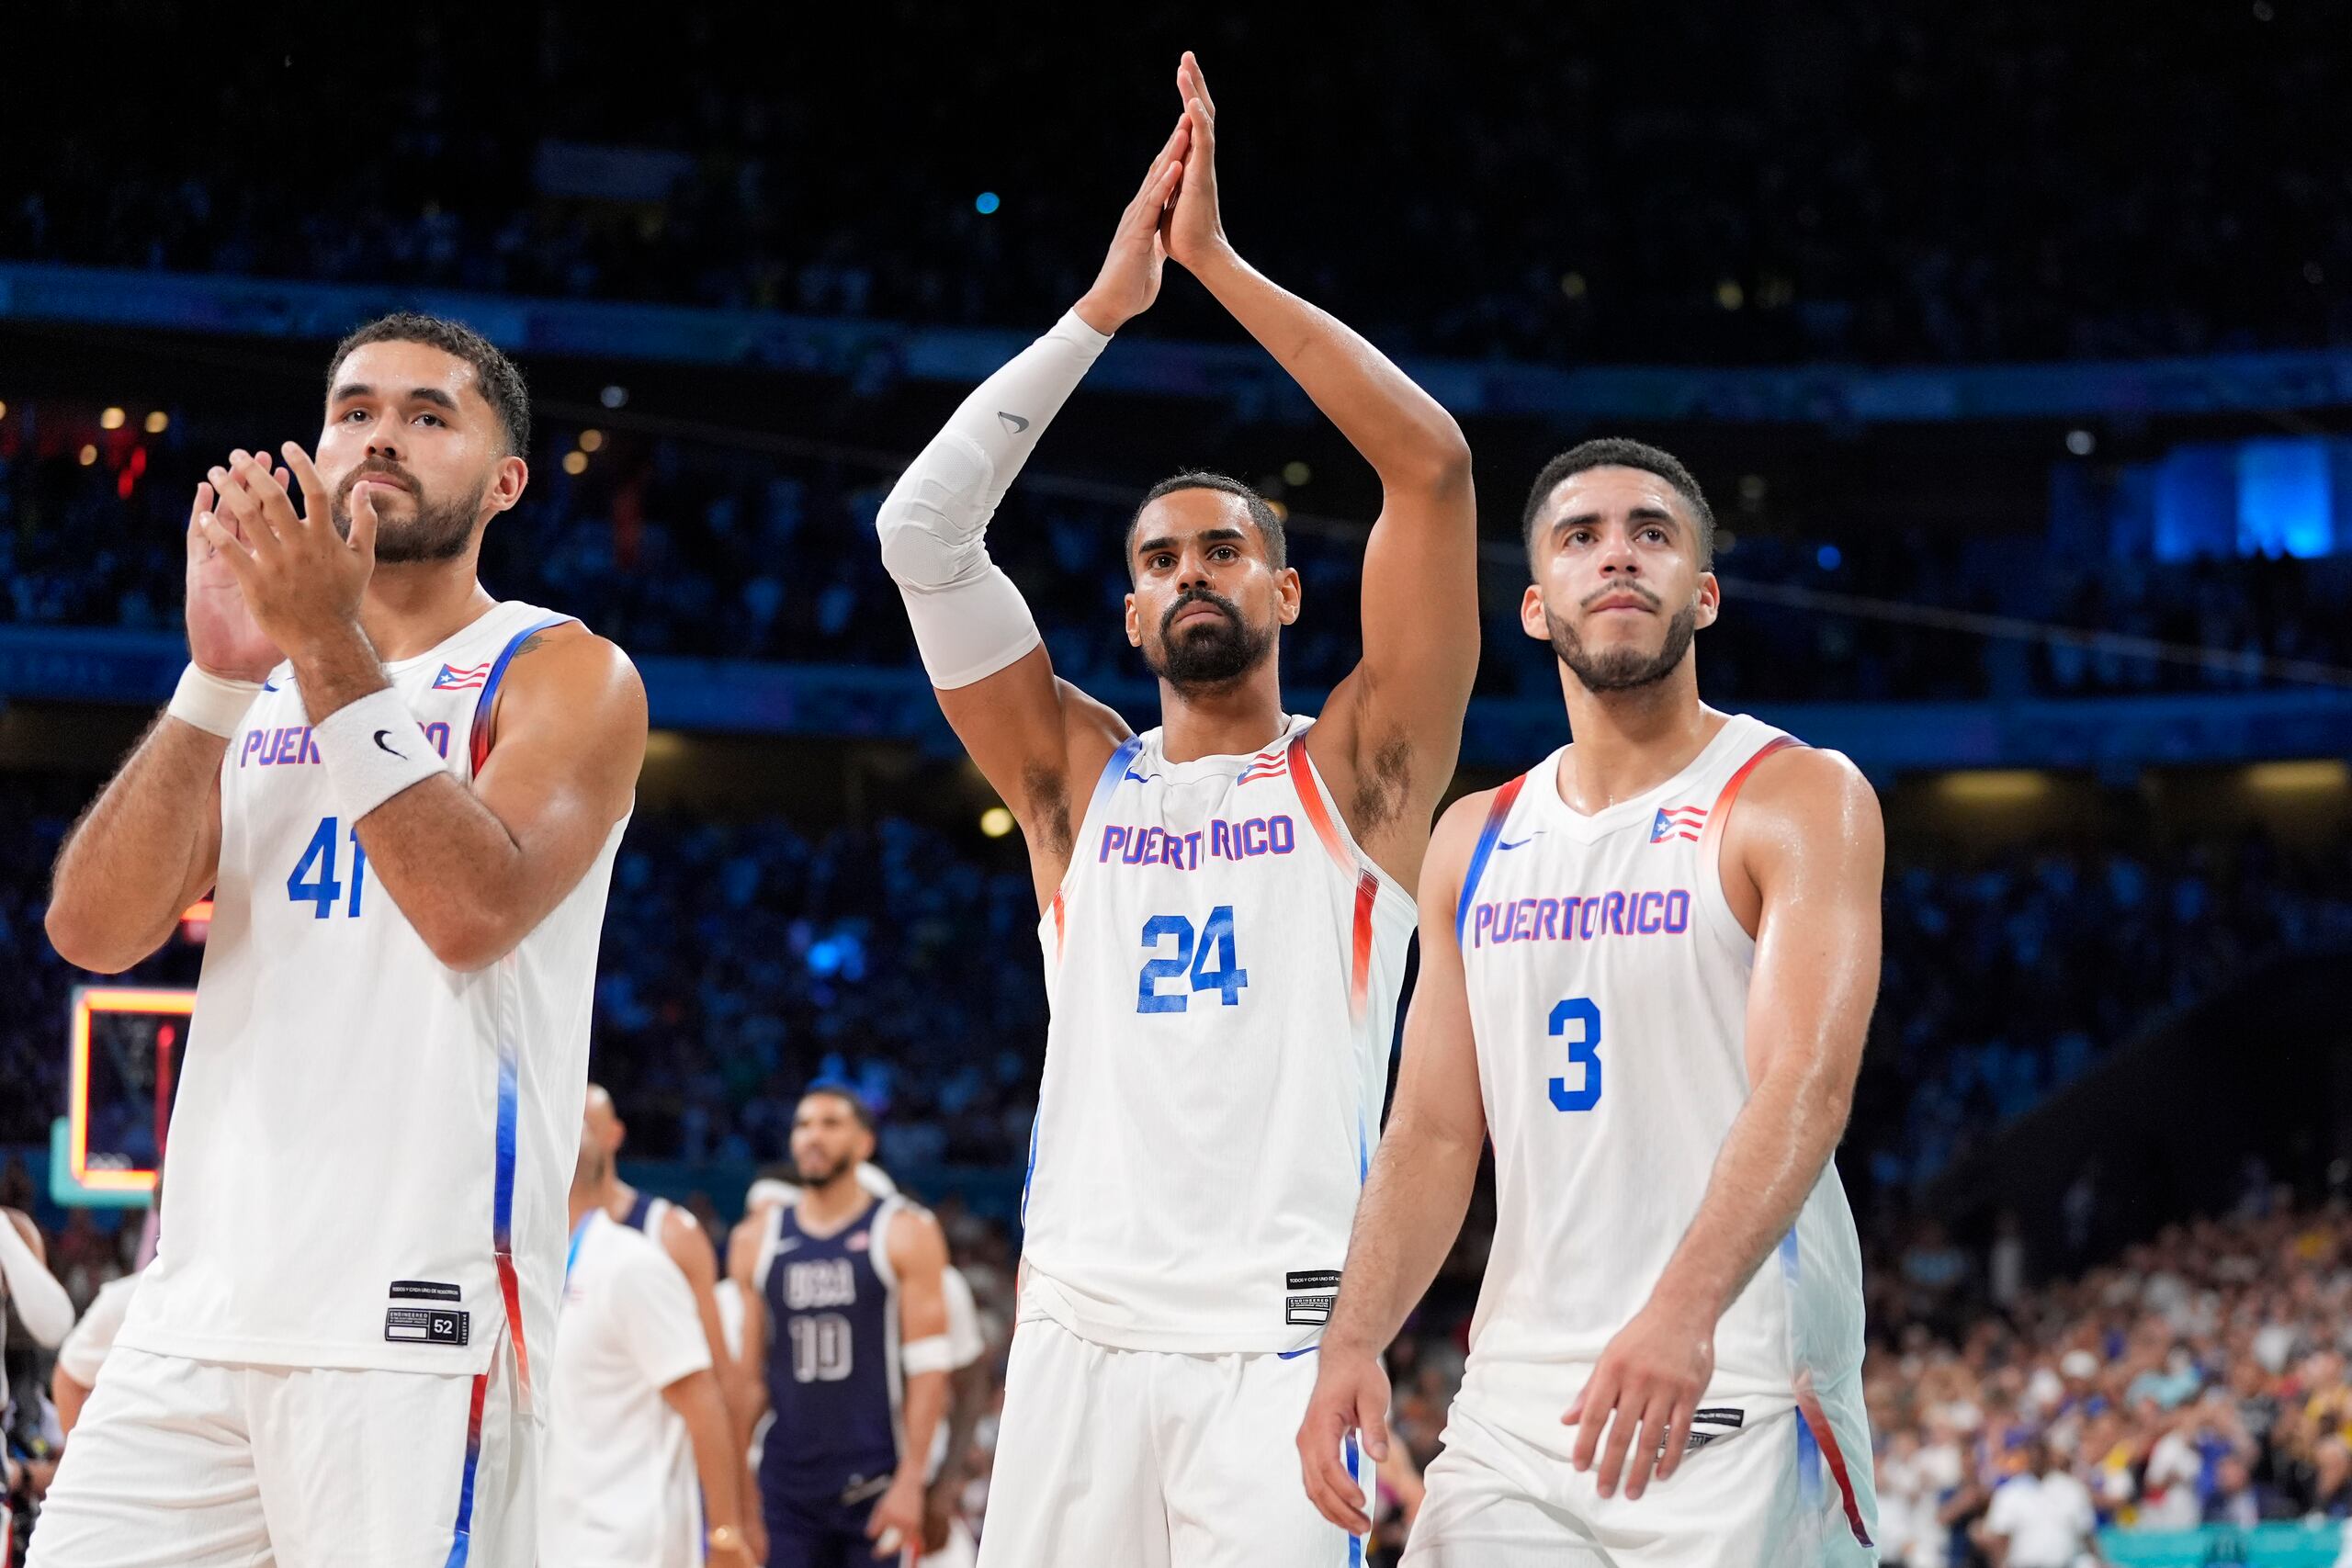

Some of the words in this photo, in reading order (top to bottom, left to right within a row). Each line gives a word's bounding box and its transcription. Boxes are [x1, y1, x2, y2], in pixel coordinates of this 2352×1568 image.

[241, 727, 321, 768] PUER
[286, 816, 366, 919] 41
[1099, 825, 1205, 871] PUERT
[1211, 815, 1295, 862] RICO
[1600, 888, 1690, 937] RICO
[1136, 905, 1249, 1014] 24
[1548, 997, 1602, 1112] 3
[784, 1258, 855, 1310] USA
[434, 1319, 452, 1334] 52
[788, 1312, 854, 1383] 10
